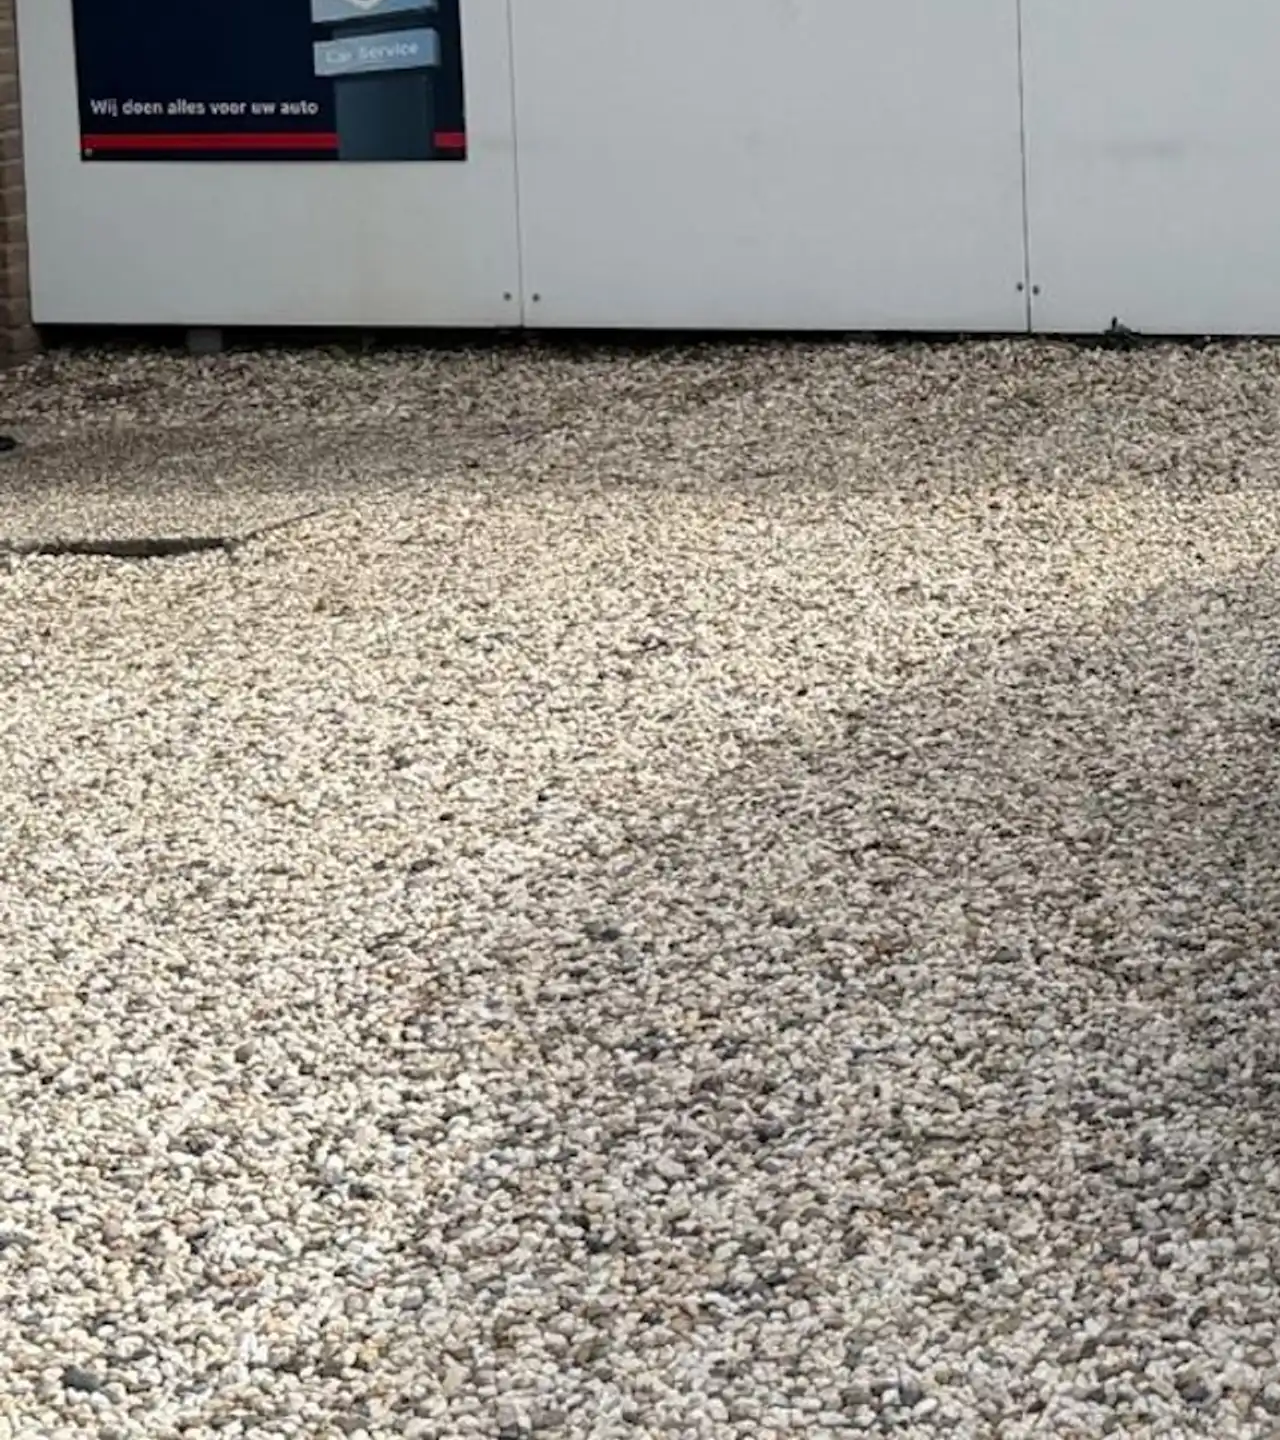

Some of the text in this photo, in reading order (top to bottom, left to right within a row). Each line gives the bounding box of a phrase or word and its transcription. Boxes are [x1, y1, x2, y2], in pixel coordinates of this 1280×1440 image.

[358, 40, 419, 60] Service
[91, 99, 319, 117] Wij doen alles voor uw auto
